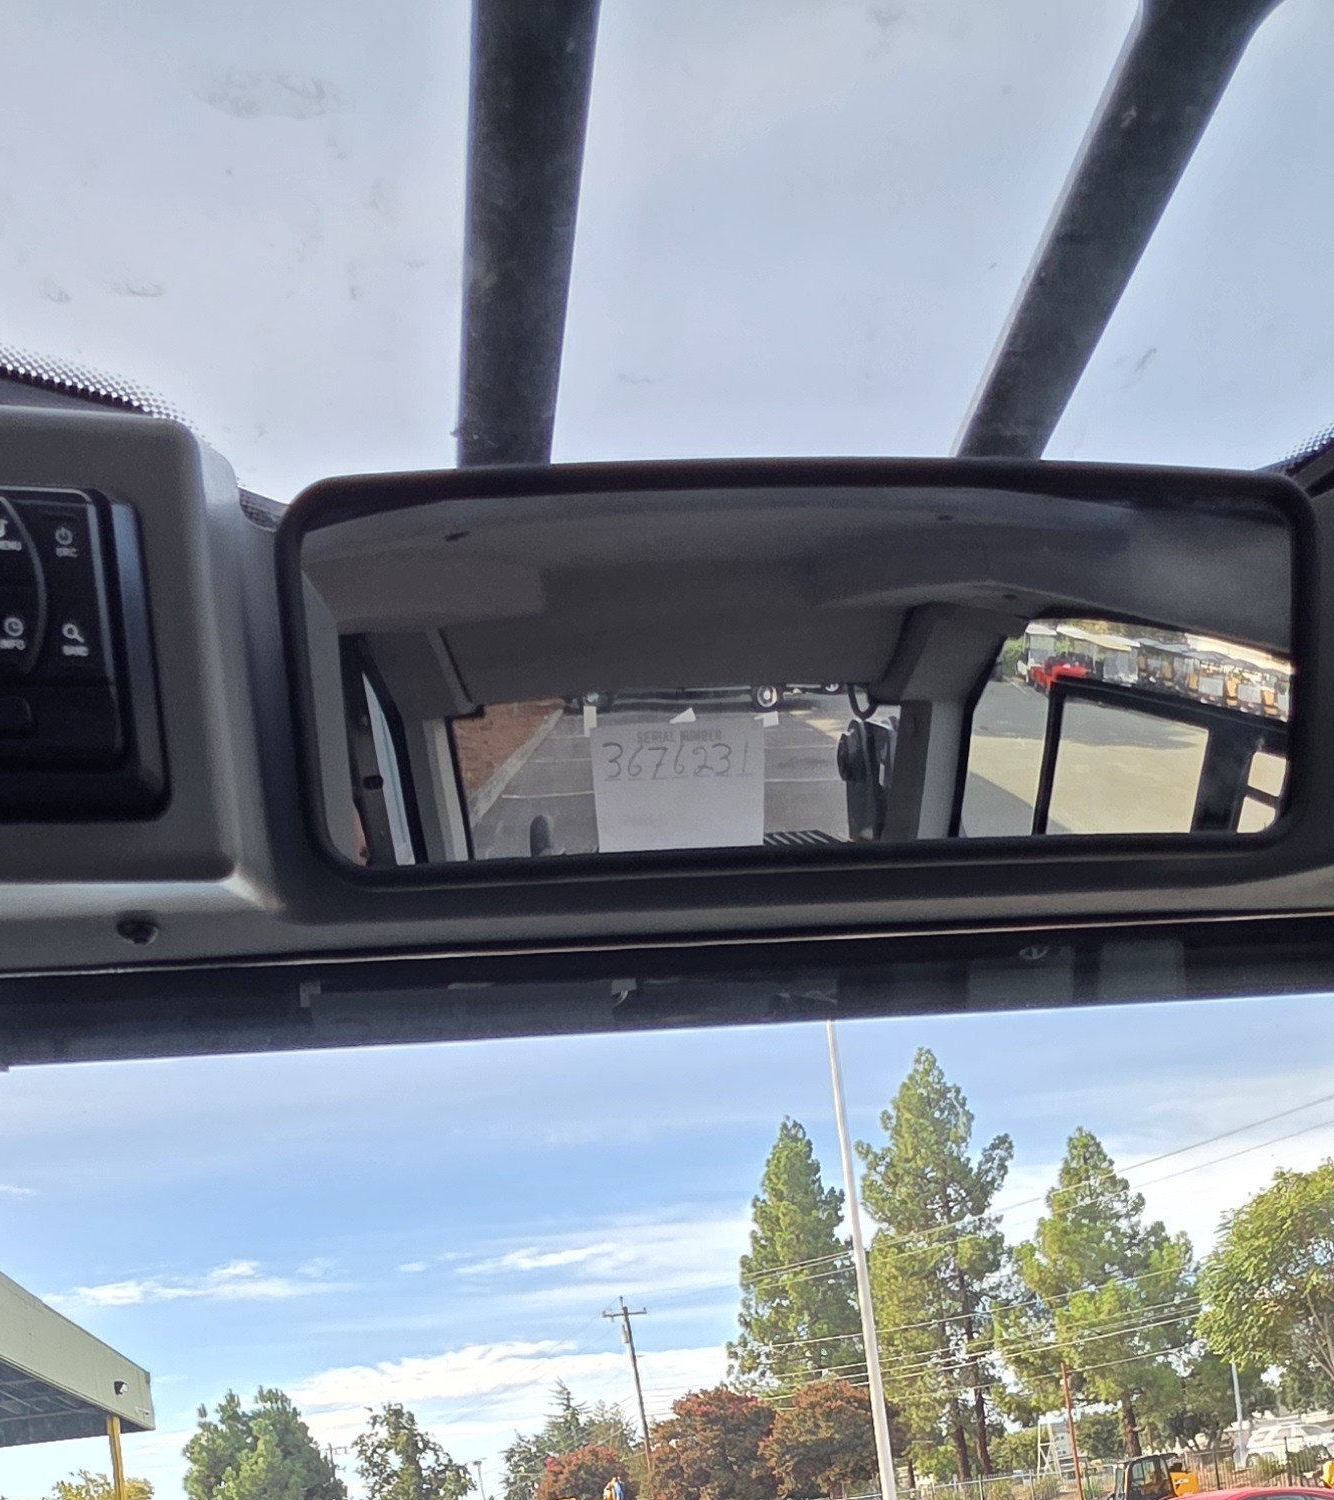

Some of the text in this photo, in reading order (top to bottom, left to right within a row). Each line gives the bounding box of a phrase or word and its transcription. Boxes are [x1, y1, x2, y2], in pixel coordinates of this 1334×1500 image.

[0, 638, 27, 650] INFO
[636, 729, 676, 744] SERIAL
[601, 741, 750, 780] 3676231
